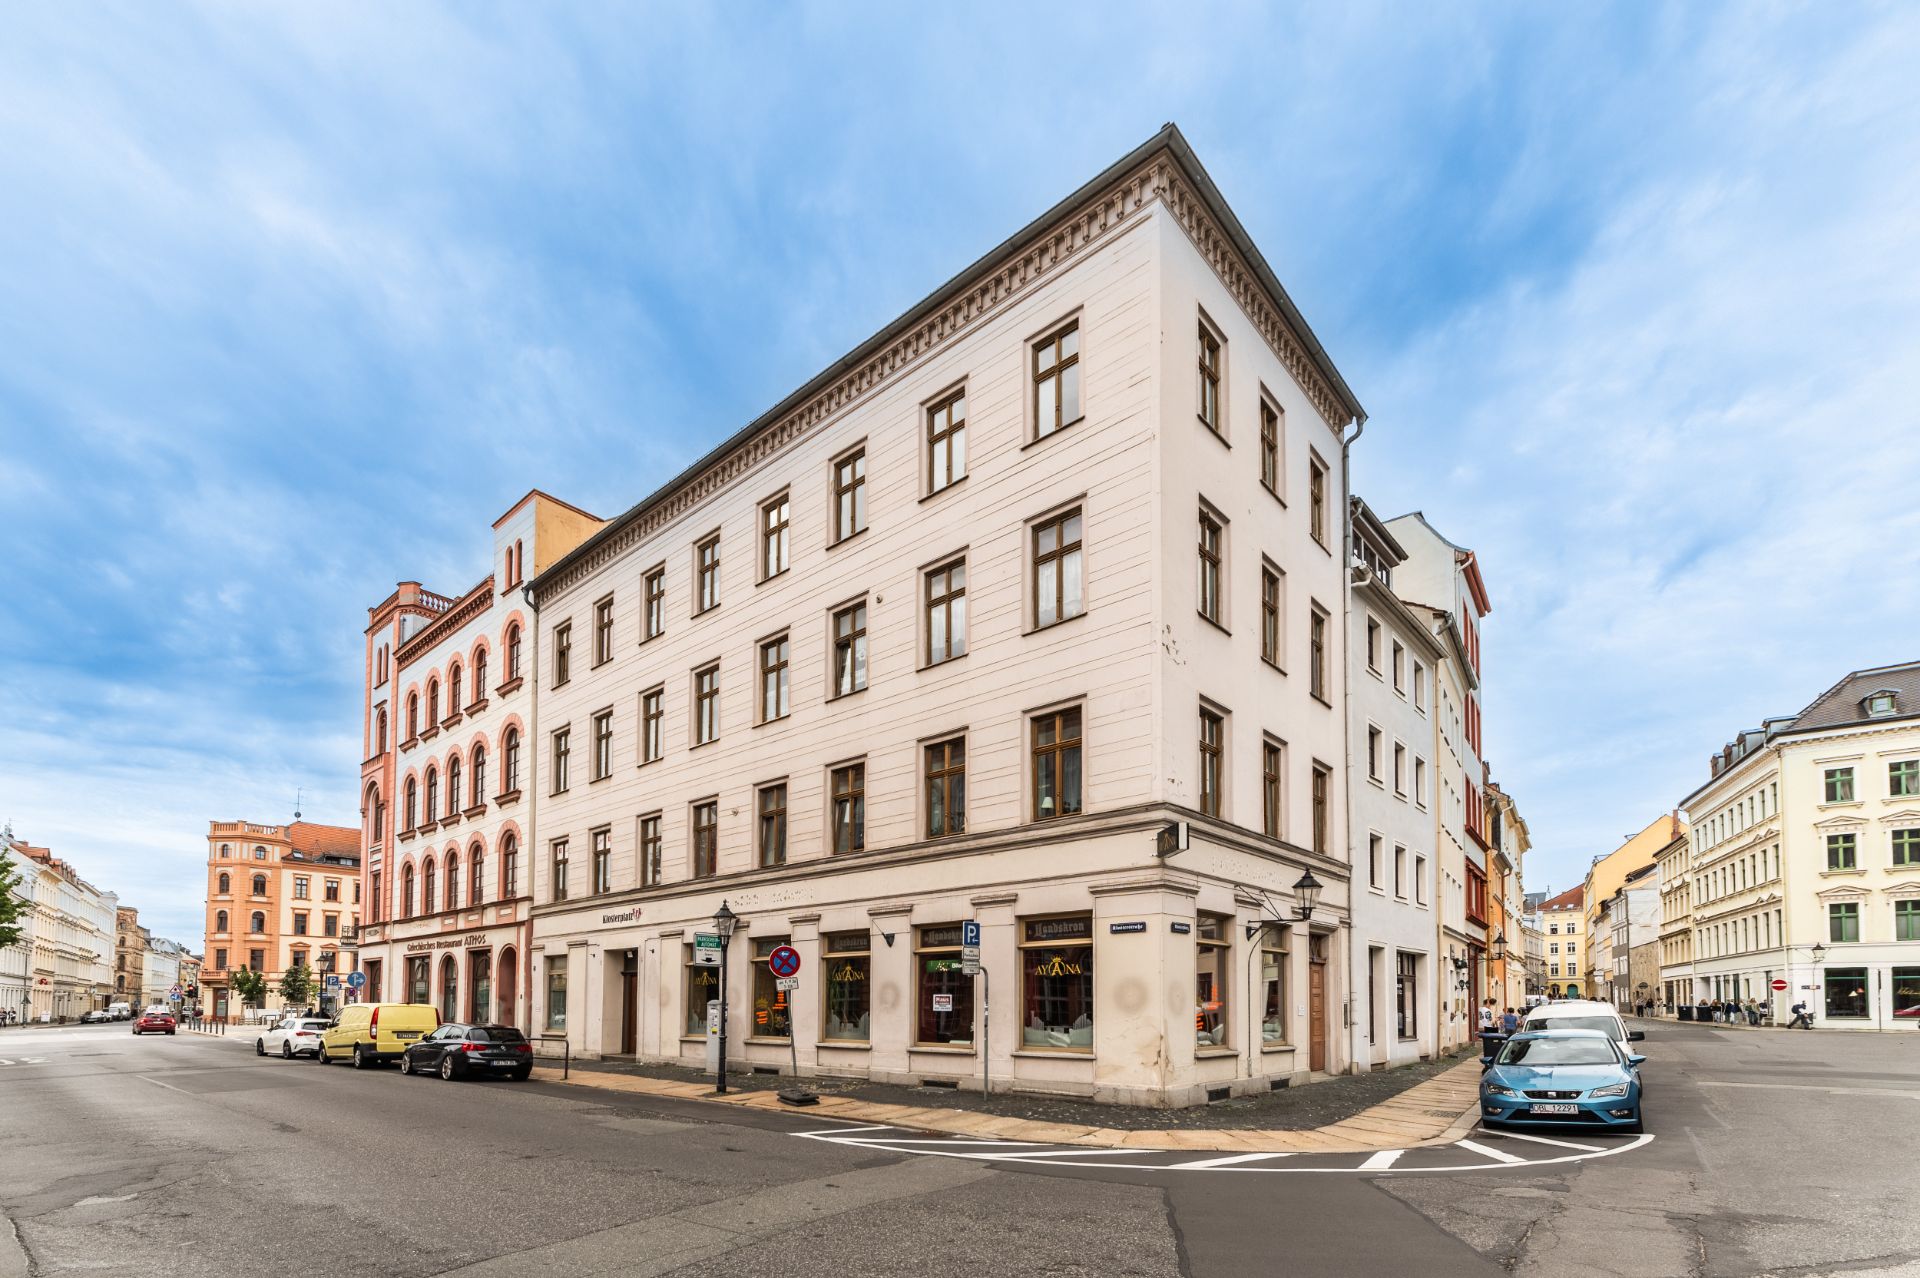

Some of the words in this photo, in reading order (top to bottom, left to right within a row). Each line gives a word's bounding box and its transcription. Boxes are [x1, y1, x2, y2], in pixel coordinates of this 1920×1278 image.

[464, 934, 486, 946] ATHOS
[967, 925, 976, 943] P
[1035, 961, 1081, 977] AYANA
